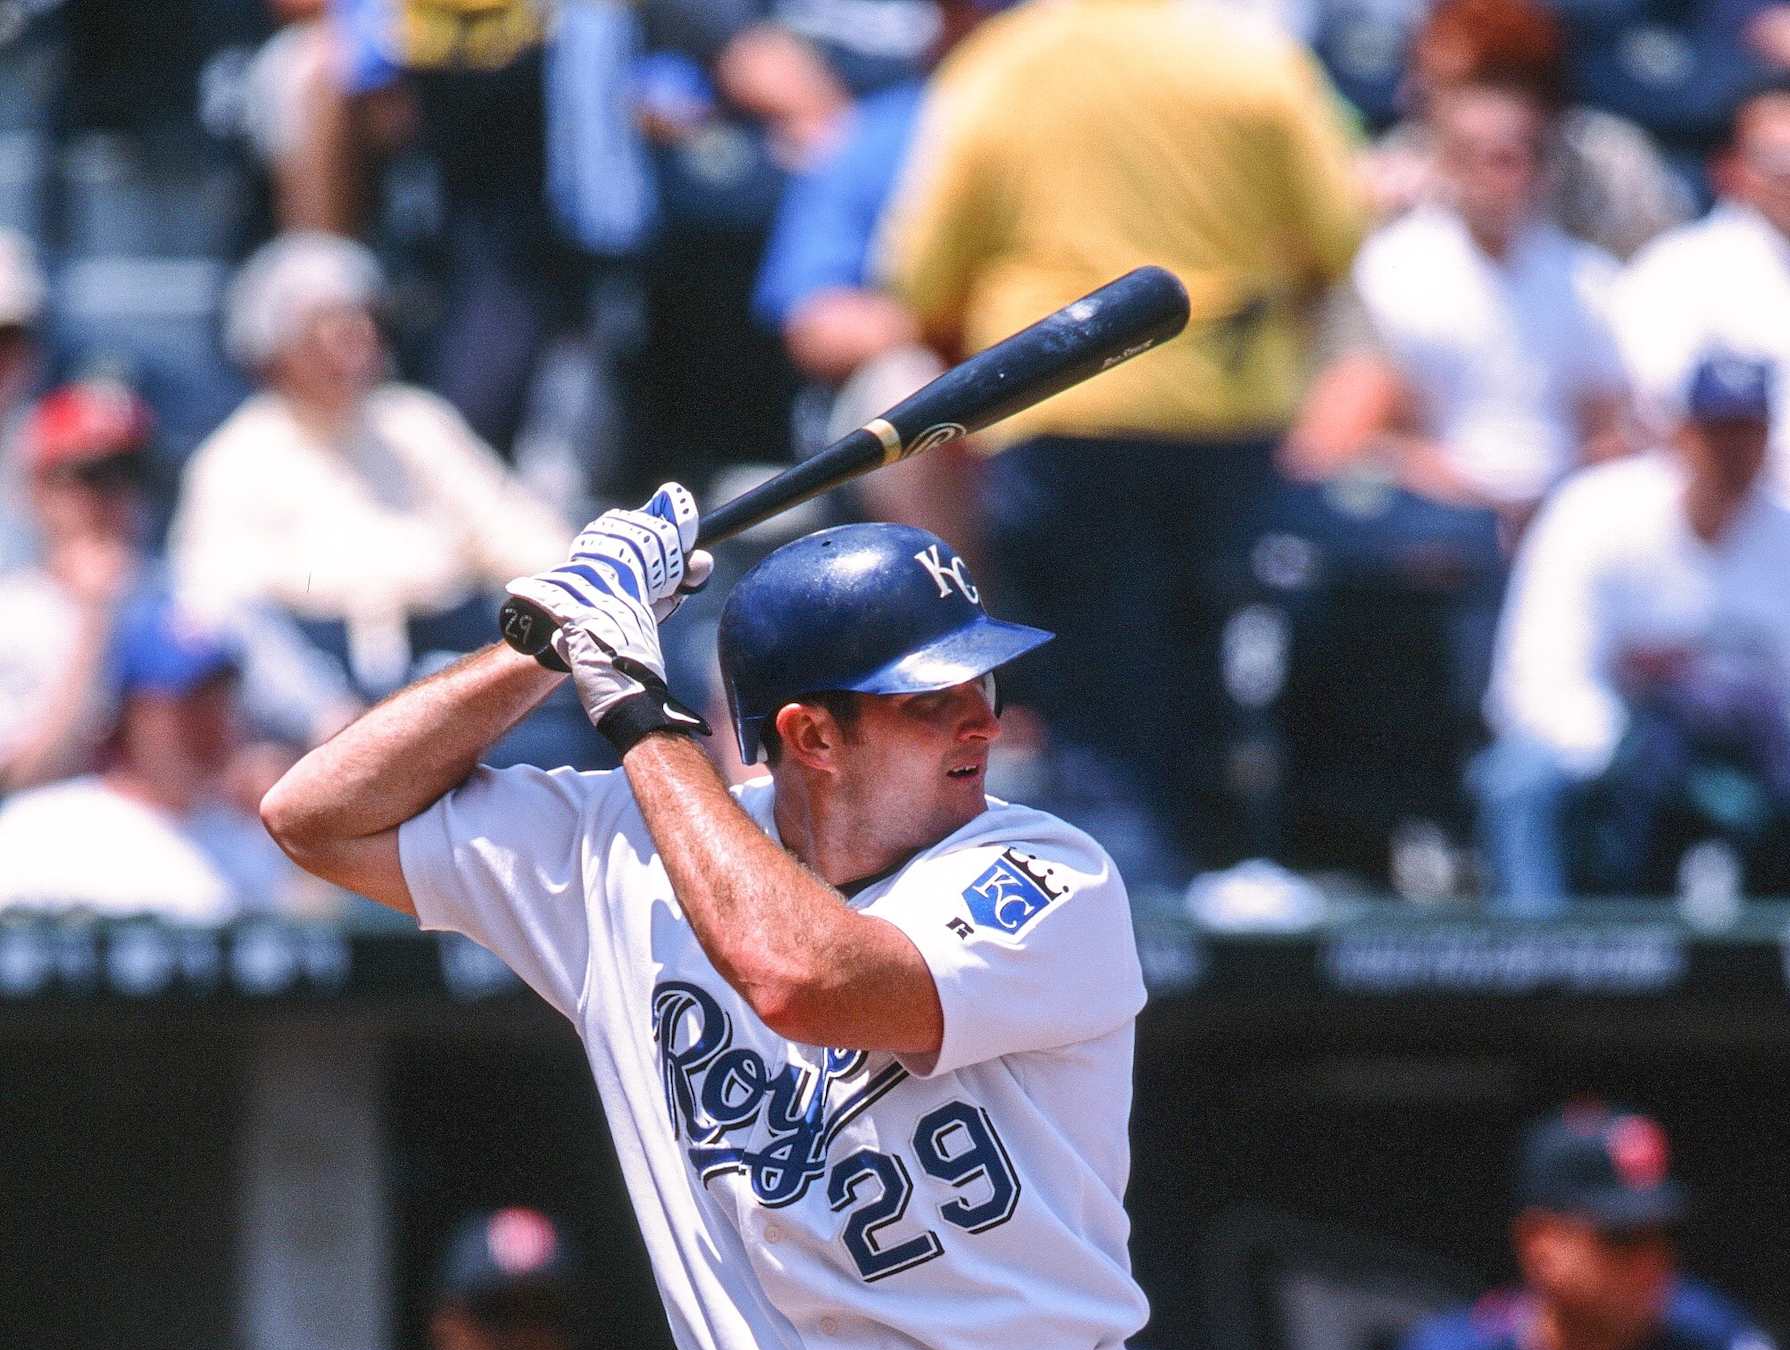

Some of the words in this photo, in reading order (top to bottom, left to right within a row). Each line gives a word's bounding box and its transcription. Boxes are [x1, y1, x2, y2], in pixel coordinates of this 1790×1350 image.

[913, 544, 979, 604] KC
[504, 608, 533, 645] 29
[972, 864, 1035, 929] KC
[651, 980, 906, 1209] Roy
[827, 1099, 1022, 1283] 29
